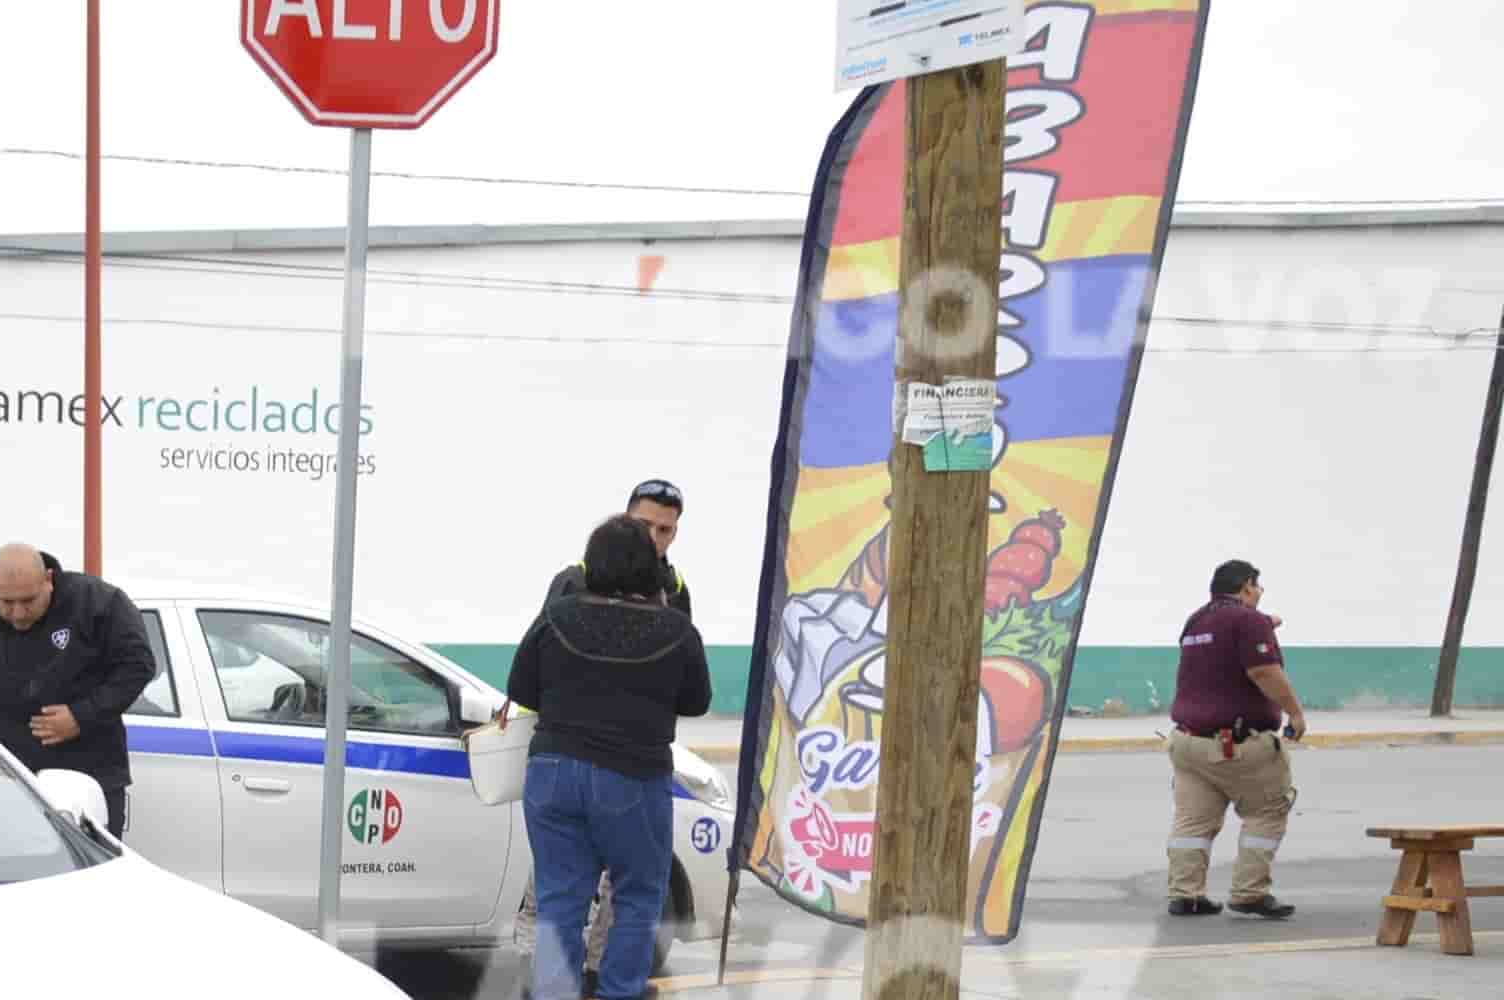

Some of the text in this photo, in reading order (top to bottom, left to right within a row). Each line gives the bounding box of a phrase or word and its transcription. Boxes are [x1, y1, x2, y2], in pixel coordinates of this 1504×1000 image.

[160, 442, 376, 481] servicios integres
[695, 823, 717, 849] 51
[338, 862, 385, 874] ONTERA,
